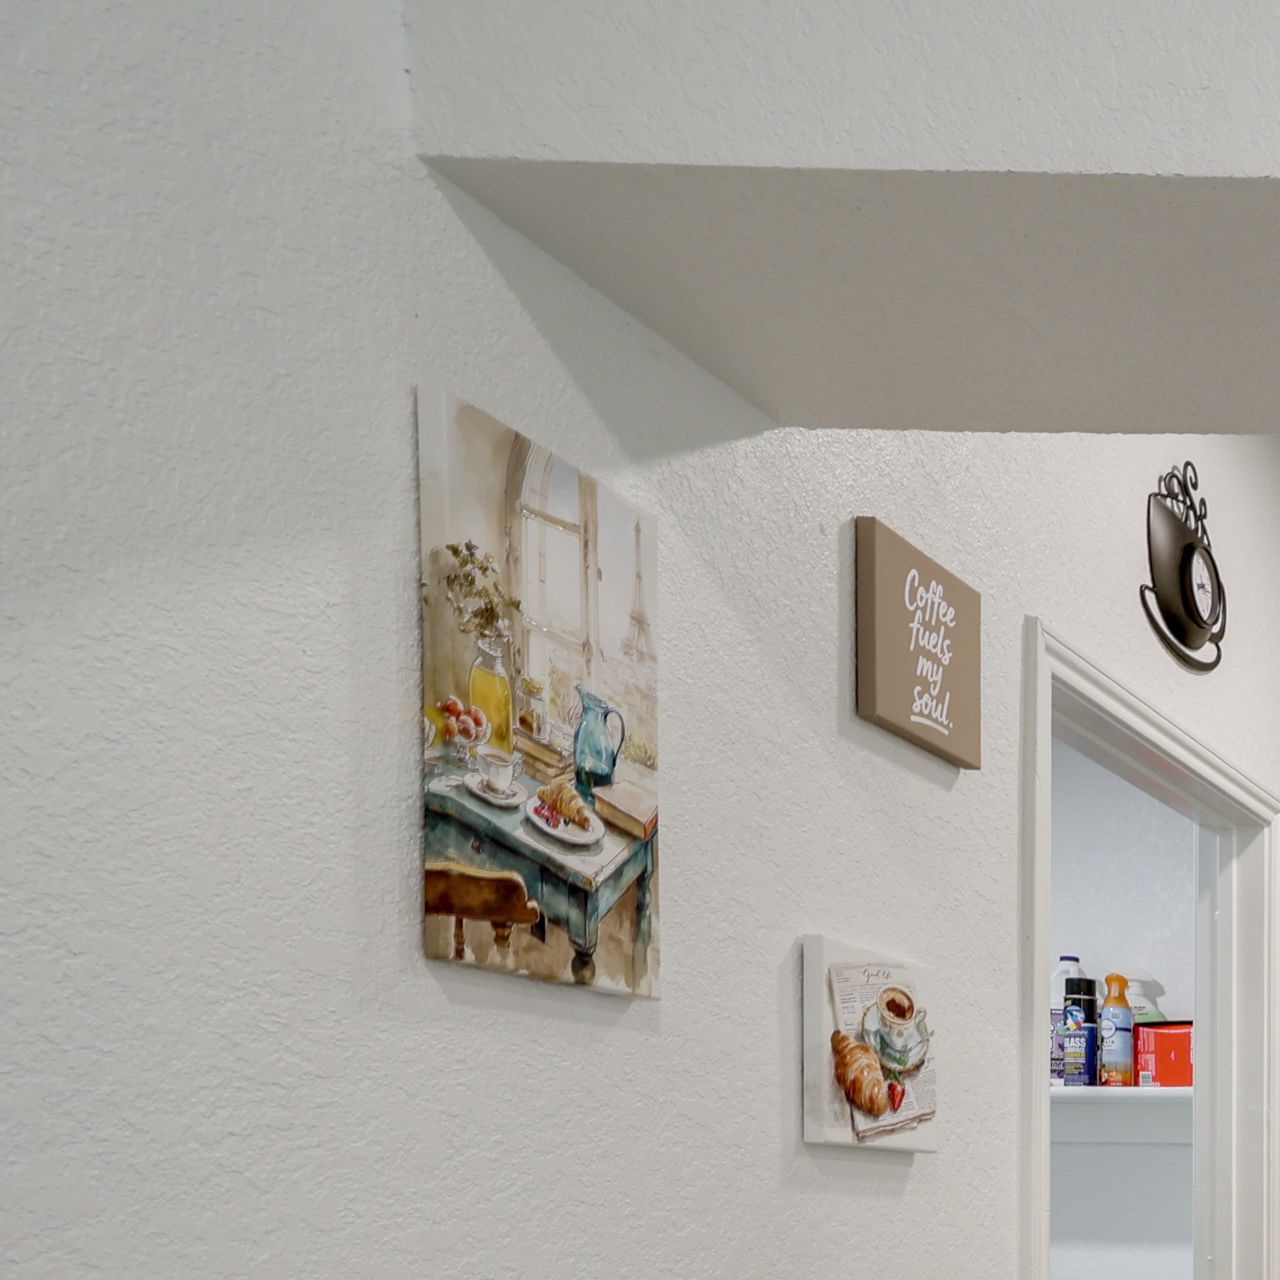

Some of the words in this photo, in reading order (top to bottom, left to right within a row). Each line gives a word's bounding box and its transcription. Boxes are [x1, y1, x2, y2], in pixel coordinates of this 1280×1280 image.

[904, 569, 956, 627] Coffee
[909, 610, 952, 665] fuels
[917, 655, 943, 696] my
[912, 686, 953, 728] soul.
